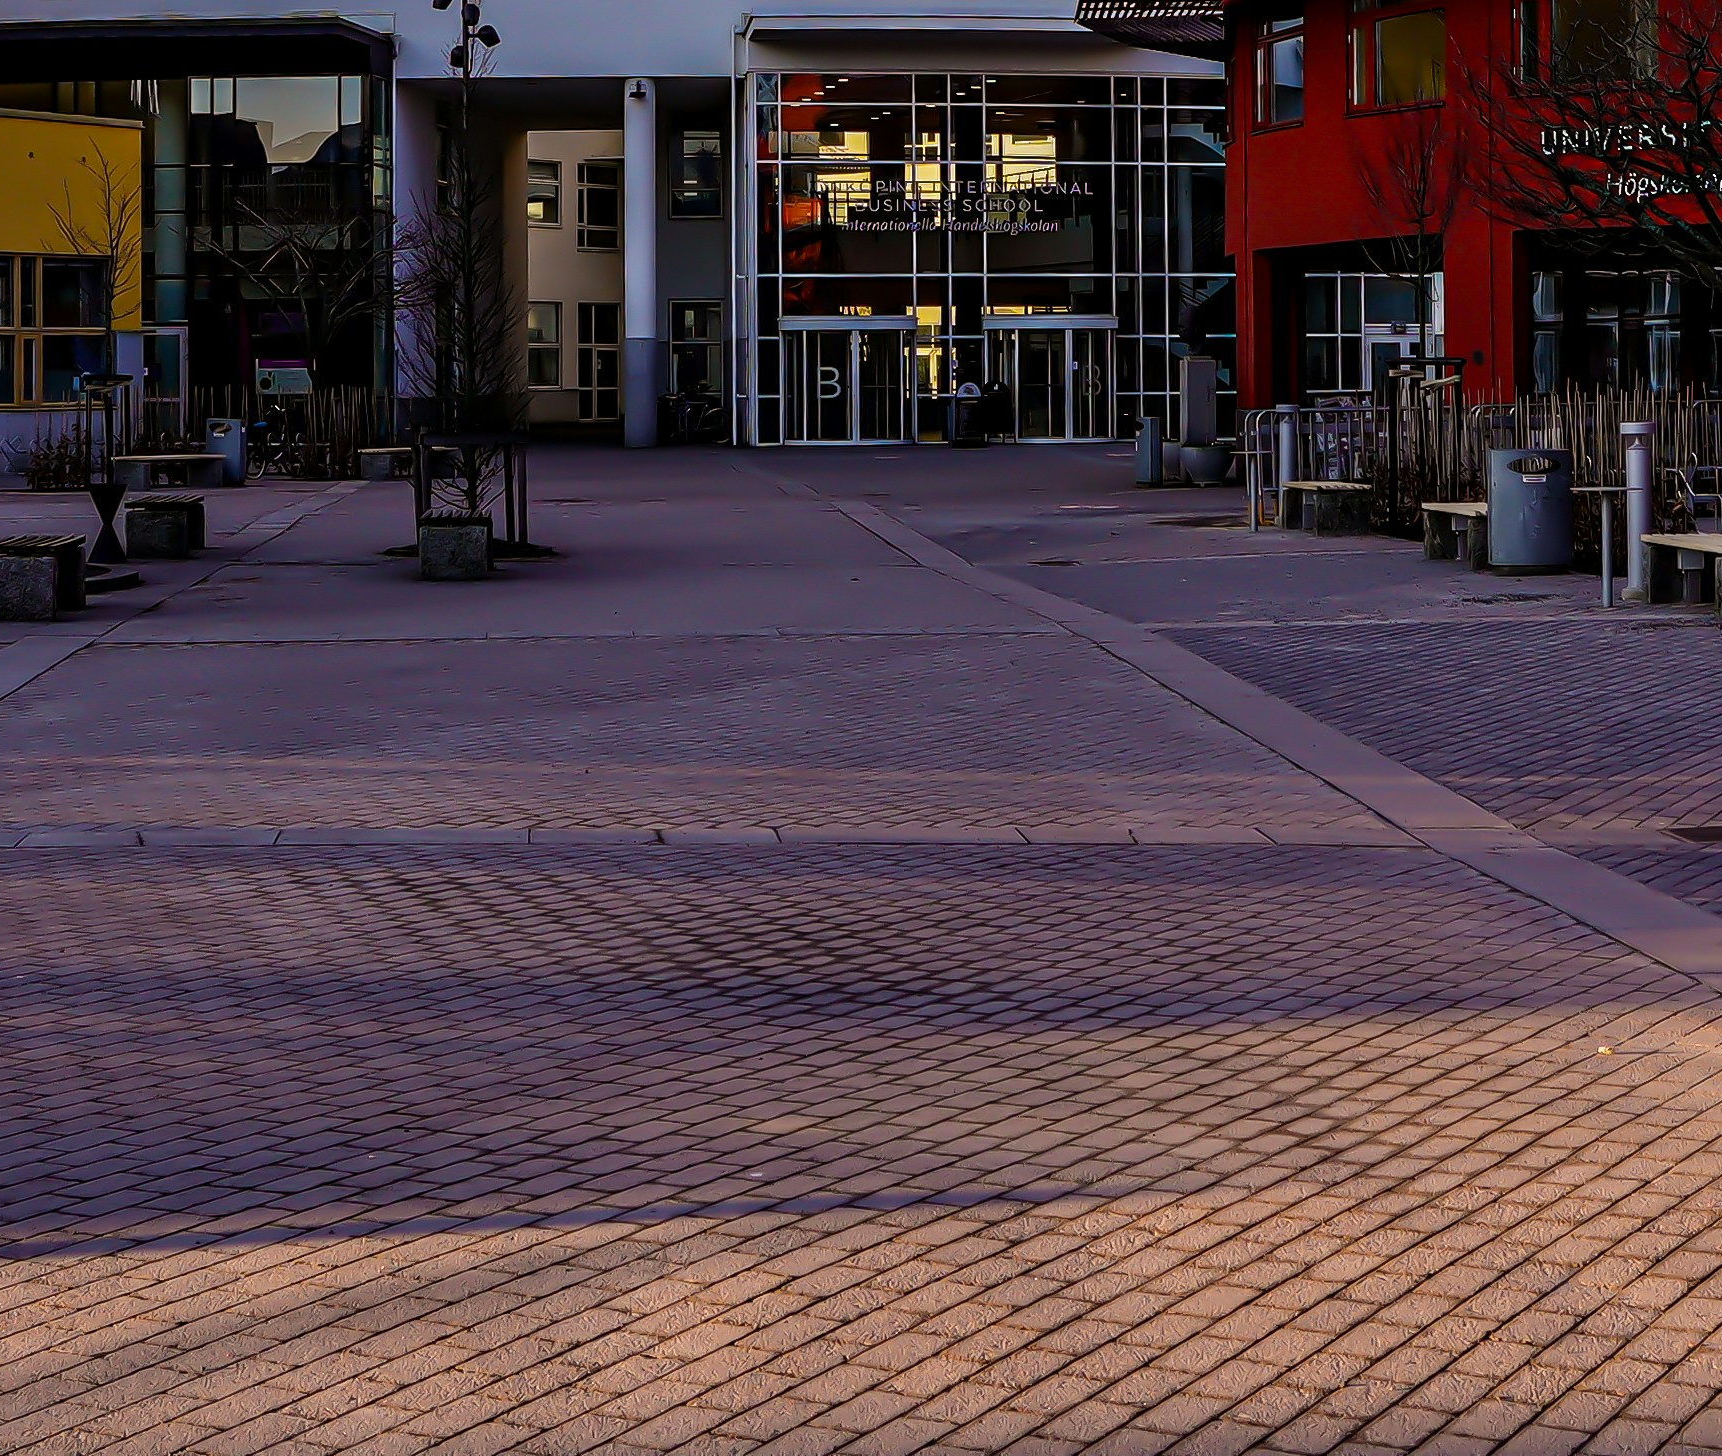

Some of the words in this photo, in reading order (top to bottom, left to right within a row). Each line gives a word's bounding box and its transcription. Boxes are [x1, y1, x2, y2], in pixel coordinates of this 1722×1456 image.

[962, 198, 1044, 213] SCHOOL
[942, 217, 1059, 236] Handelshögskolan
[817, 366, 841, 399] B
